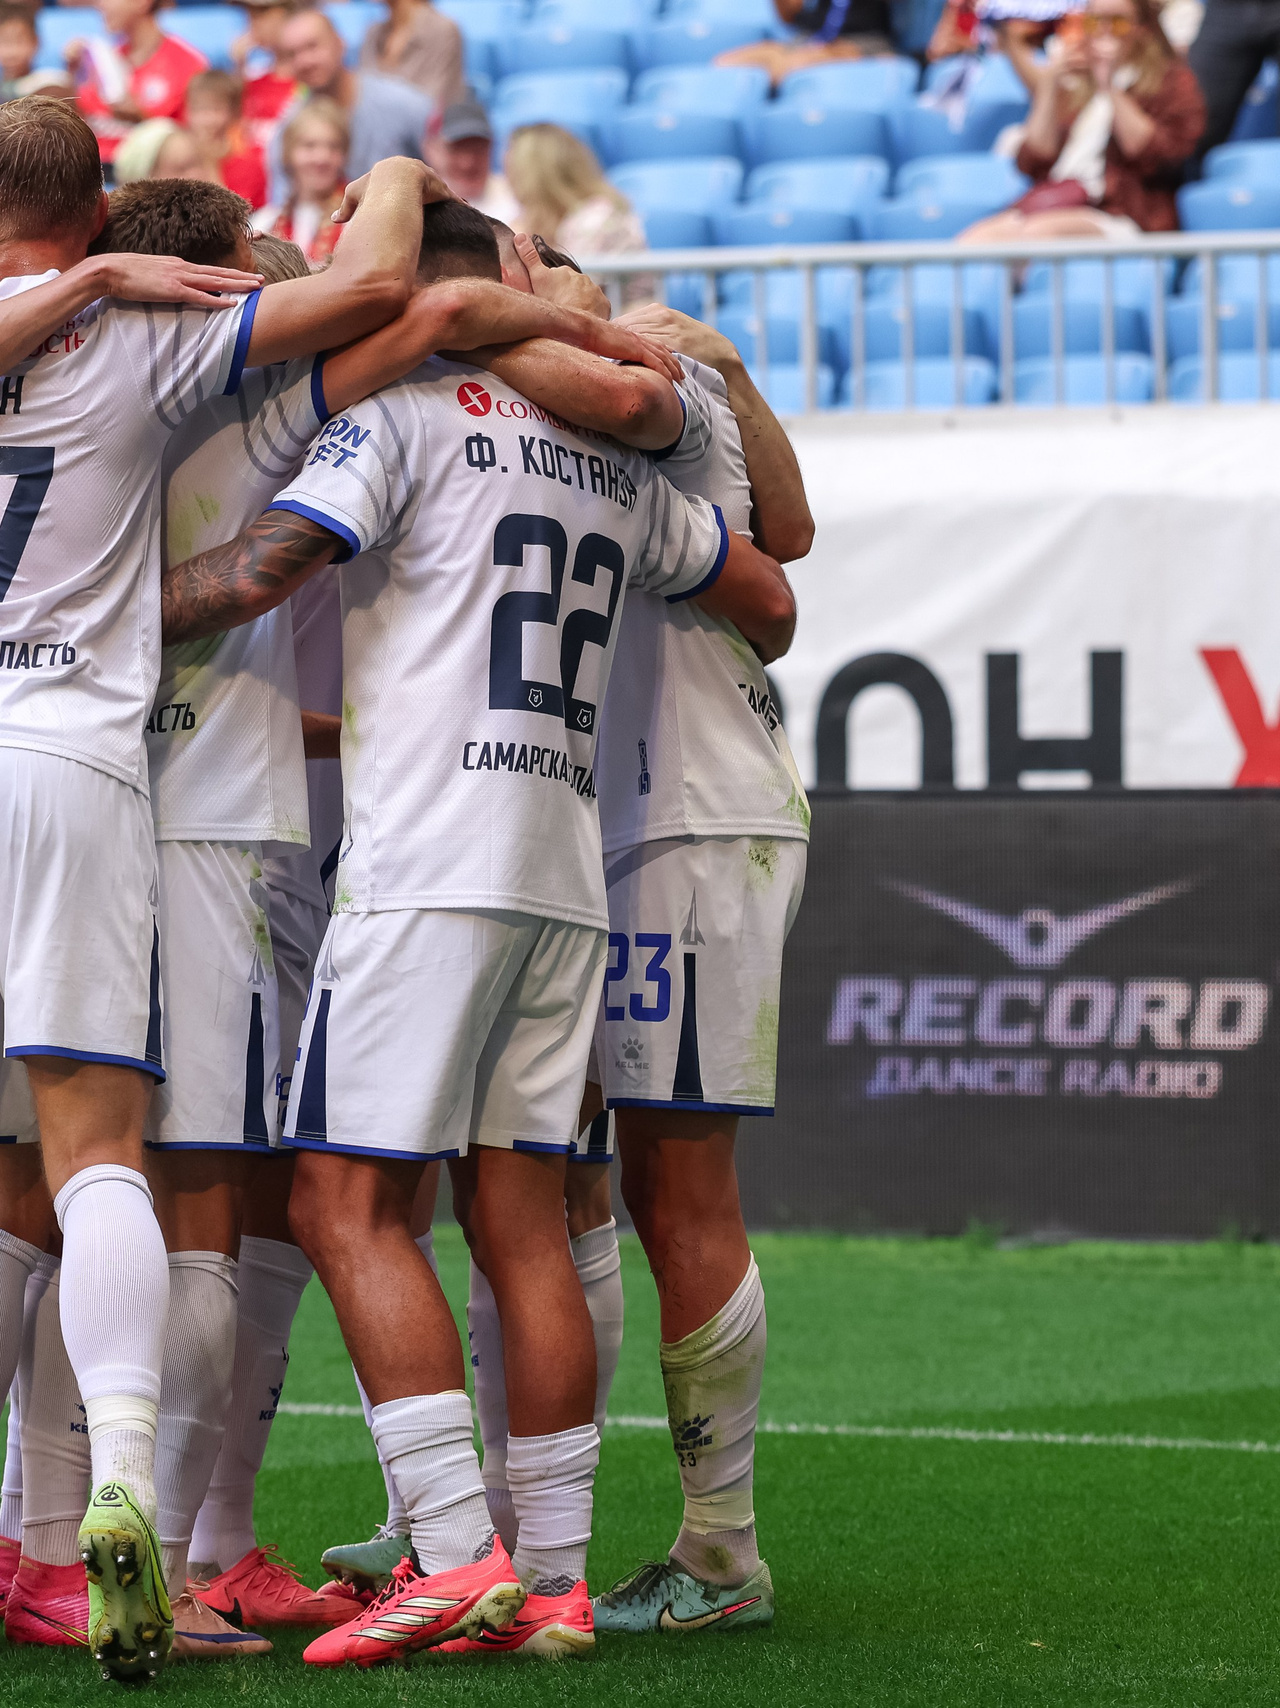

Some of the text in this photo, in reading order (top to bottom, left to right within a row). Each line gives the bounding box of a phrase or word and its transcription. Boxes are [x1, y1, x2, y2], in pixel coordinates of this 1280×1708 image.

[465, 432, 638, 514] Ф. КОСТАНЗА
[488, 512, 626, 737] 22
[604, 932, 672, 1023] 23
[827, 976, 1269, 1051] RECORD
[615, 1060, 650, 1070] KELME
[865, 1056, 1223, 1100] DANCE RADIO
[673, 1435, 713, 1451] KELME
[678, 1451, 697, 1468] 23
